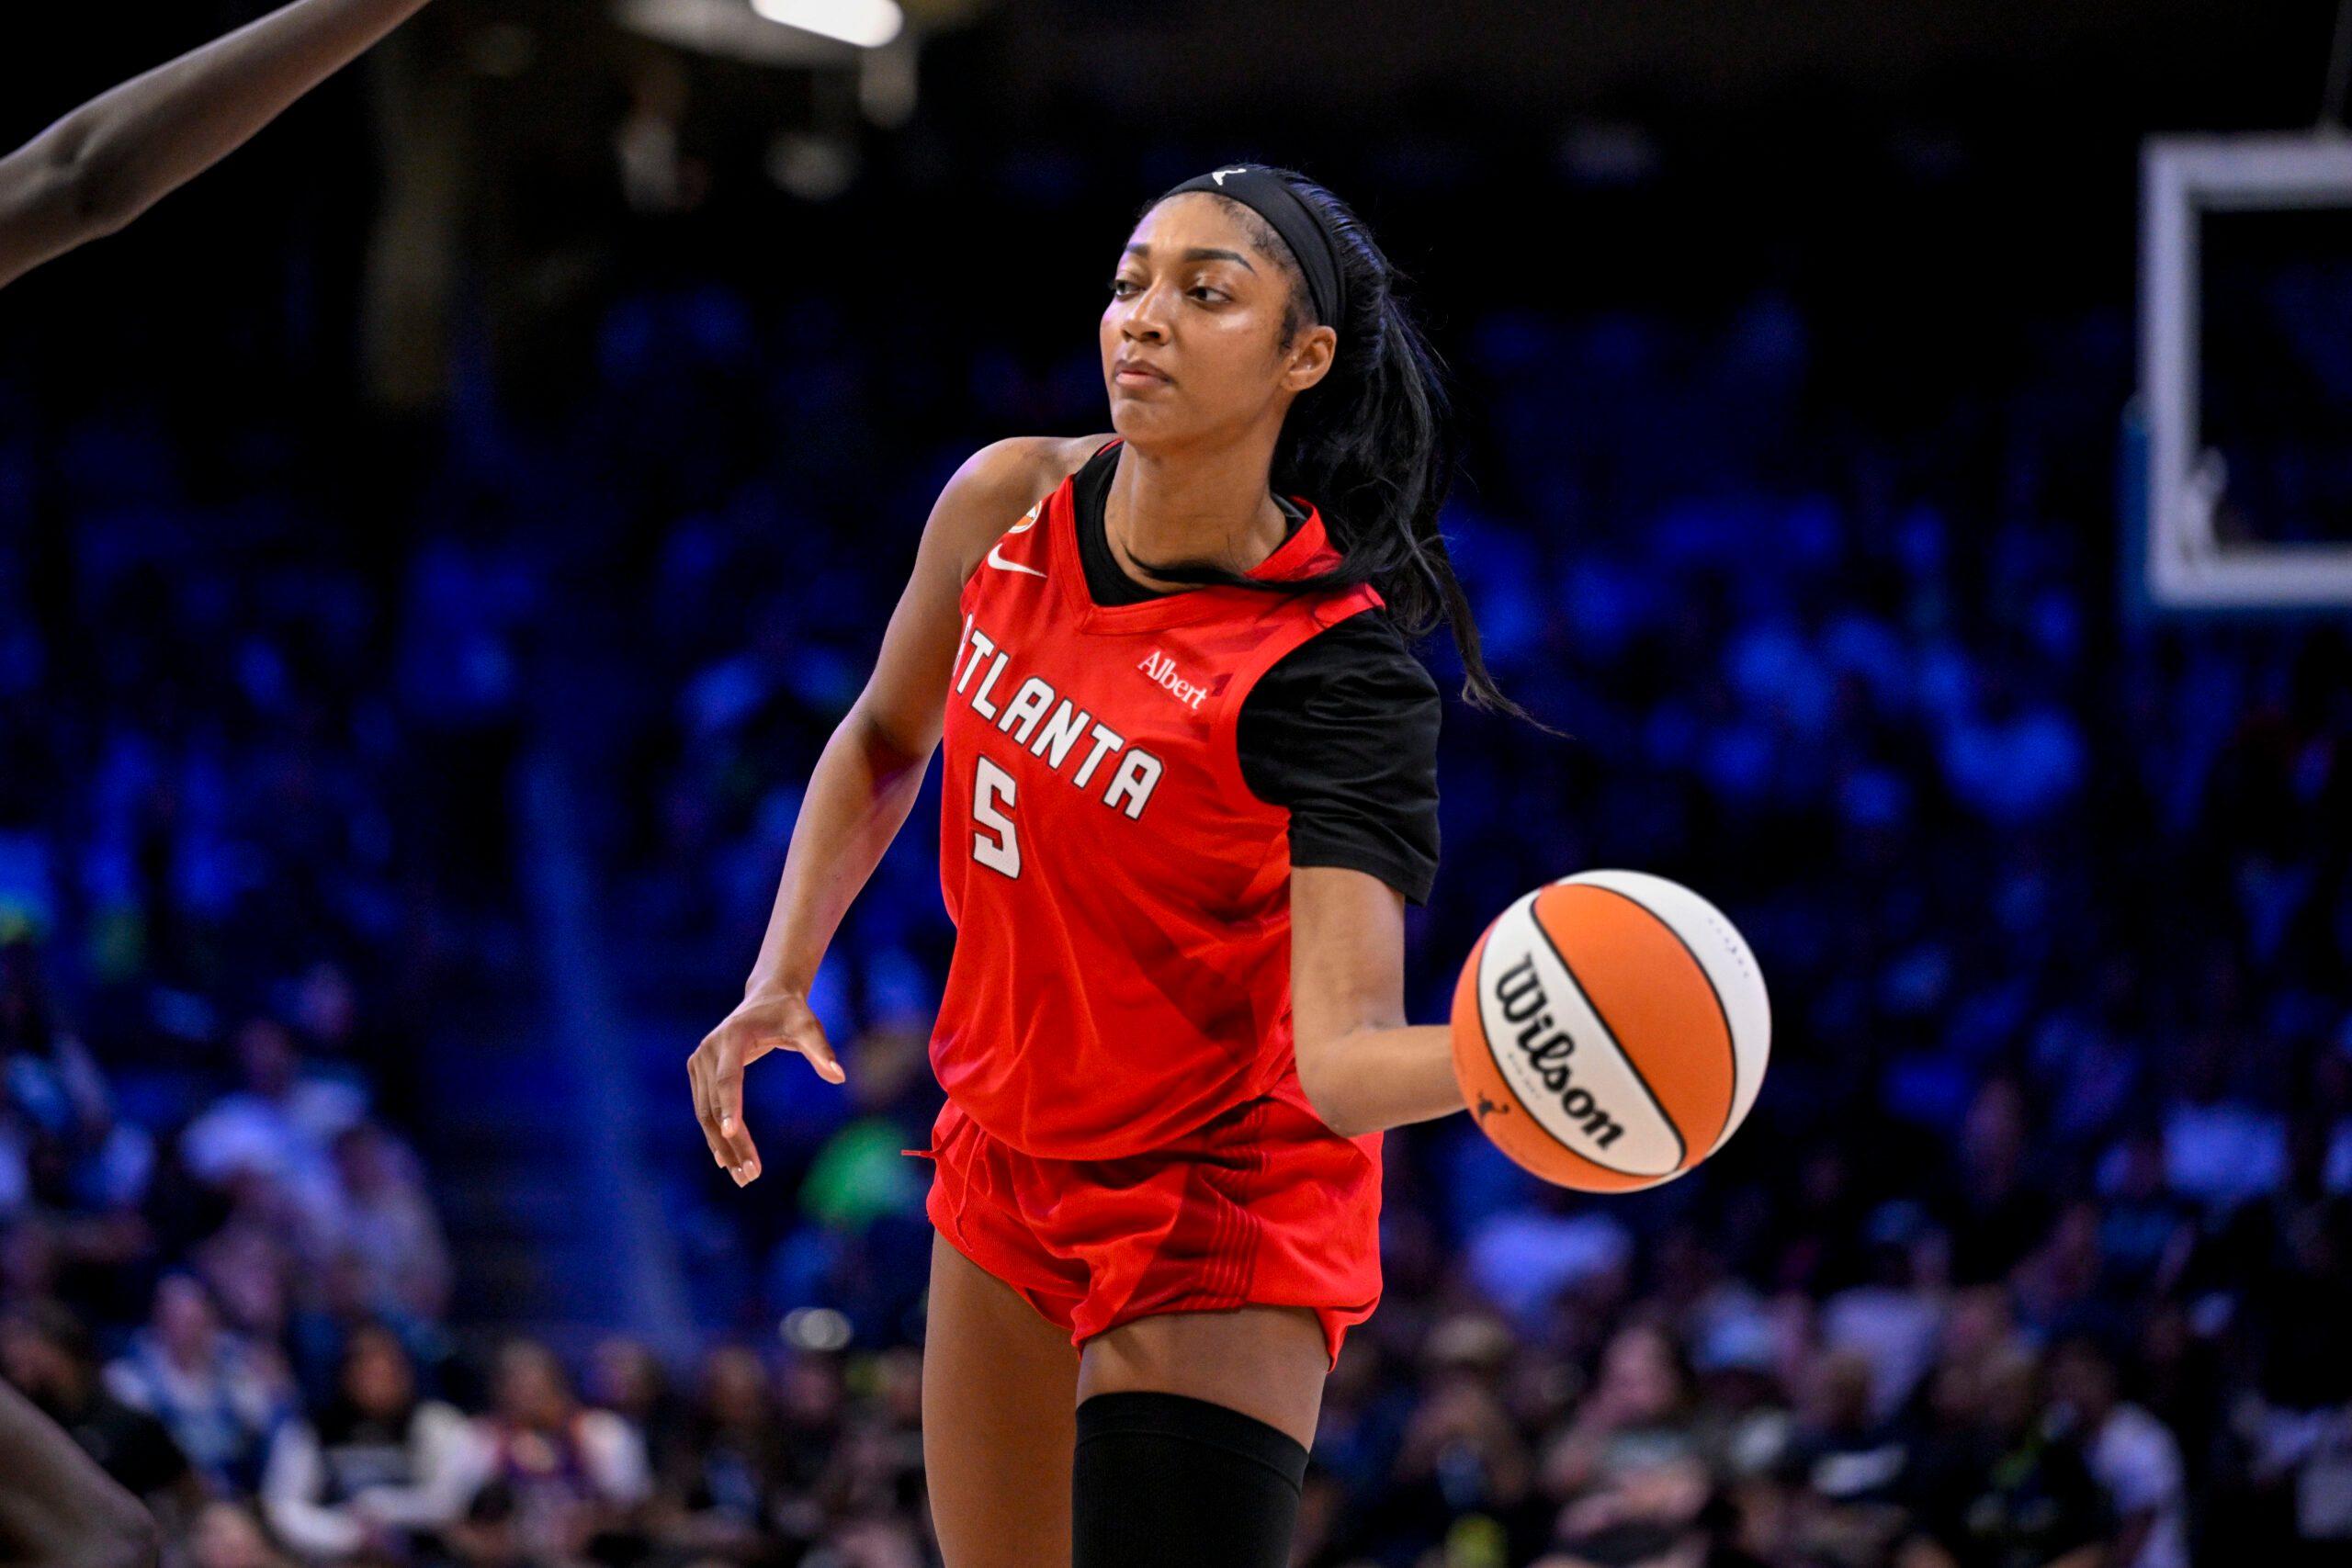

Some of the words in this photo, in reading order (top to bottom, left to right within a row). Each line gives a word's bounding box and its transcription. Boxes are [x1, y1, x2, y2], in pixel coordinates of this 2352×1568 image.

[1137, 650, 1208, 710] Albert
[973, 755, 1022, 879] 5
[1495, 952, 1625, 1149] Wilson
